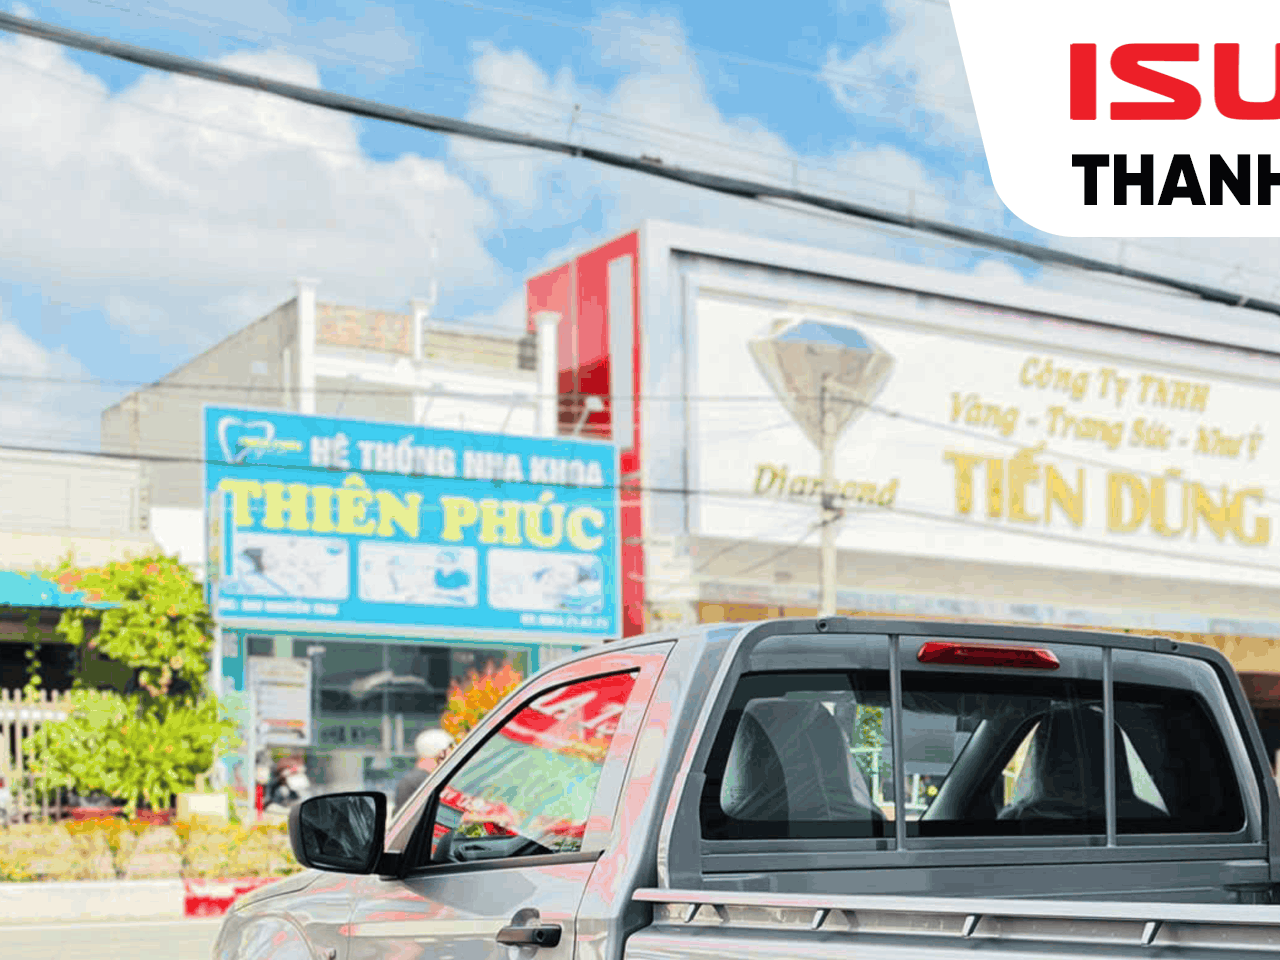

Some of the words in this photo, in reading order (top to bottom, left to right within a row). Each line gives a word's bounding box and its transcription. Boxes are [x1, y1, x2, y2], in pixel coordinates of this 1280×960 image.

[218, 473, 422, 538] THIÊN
[439, 489, 606, 550] PHÚC
[943, 440, 1086, 530] TIẾN
